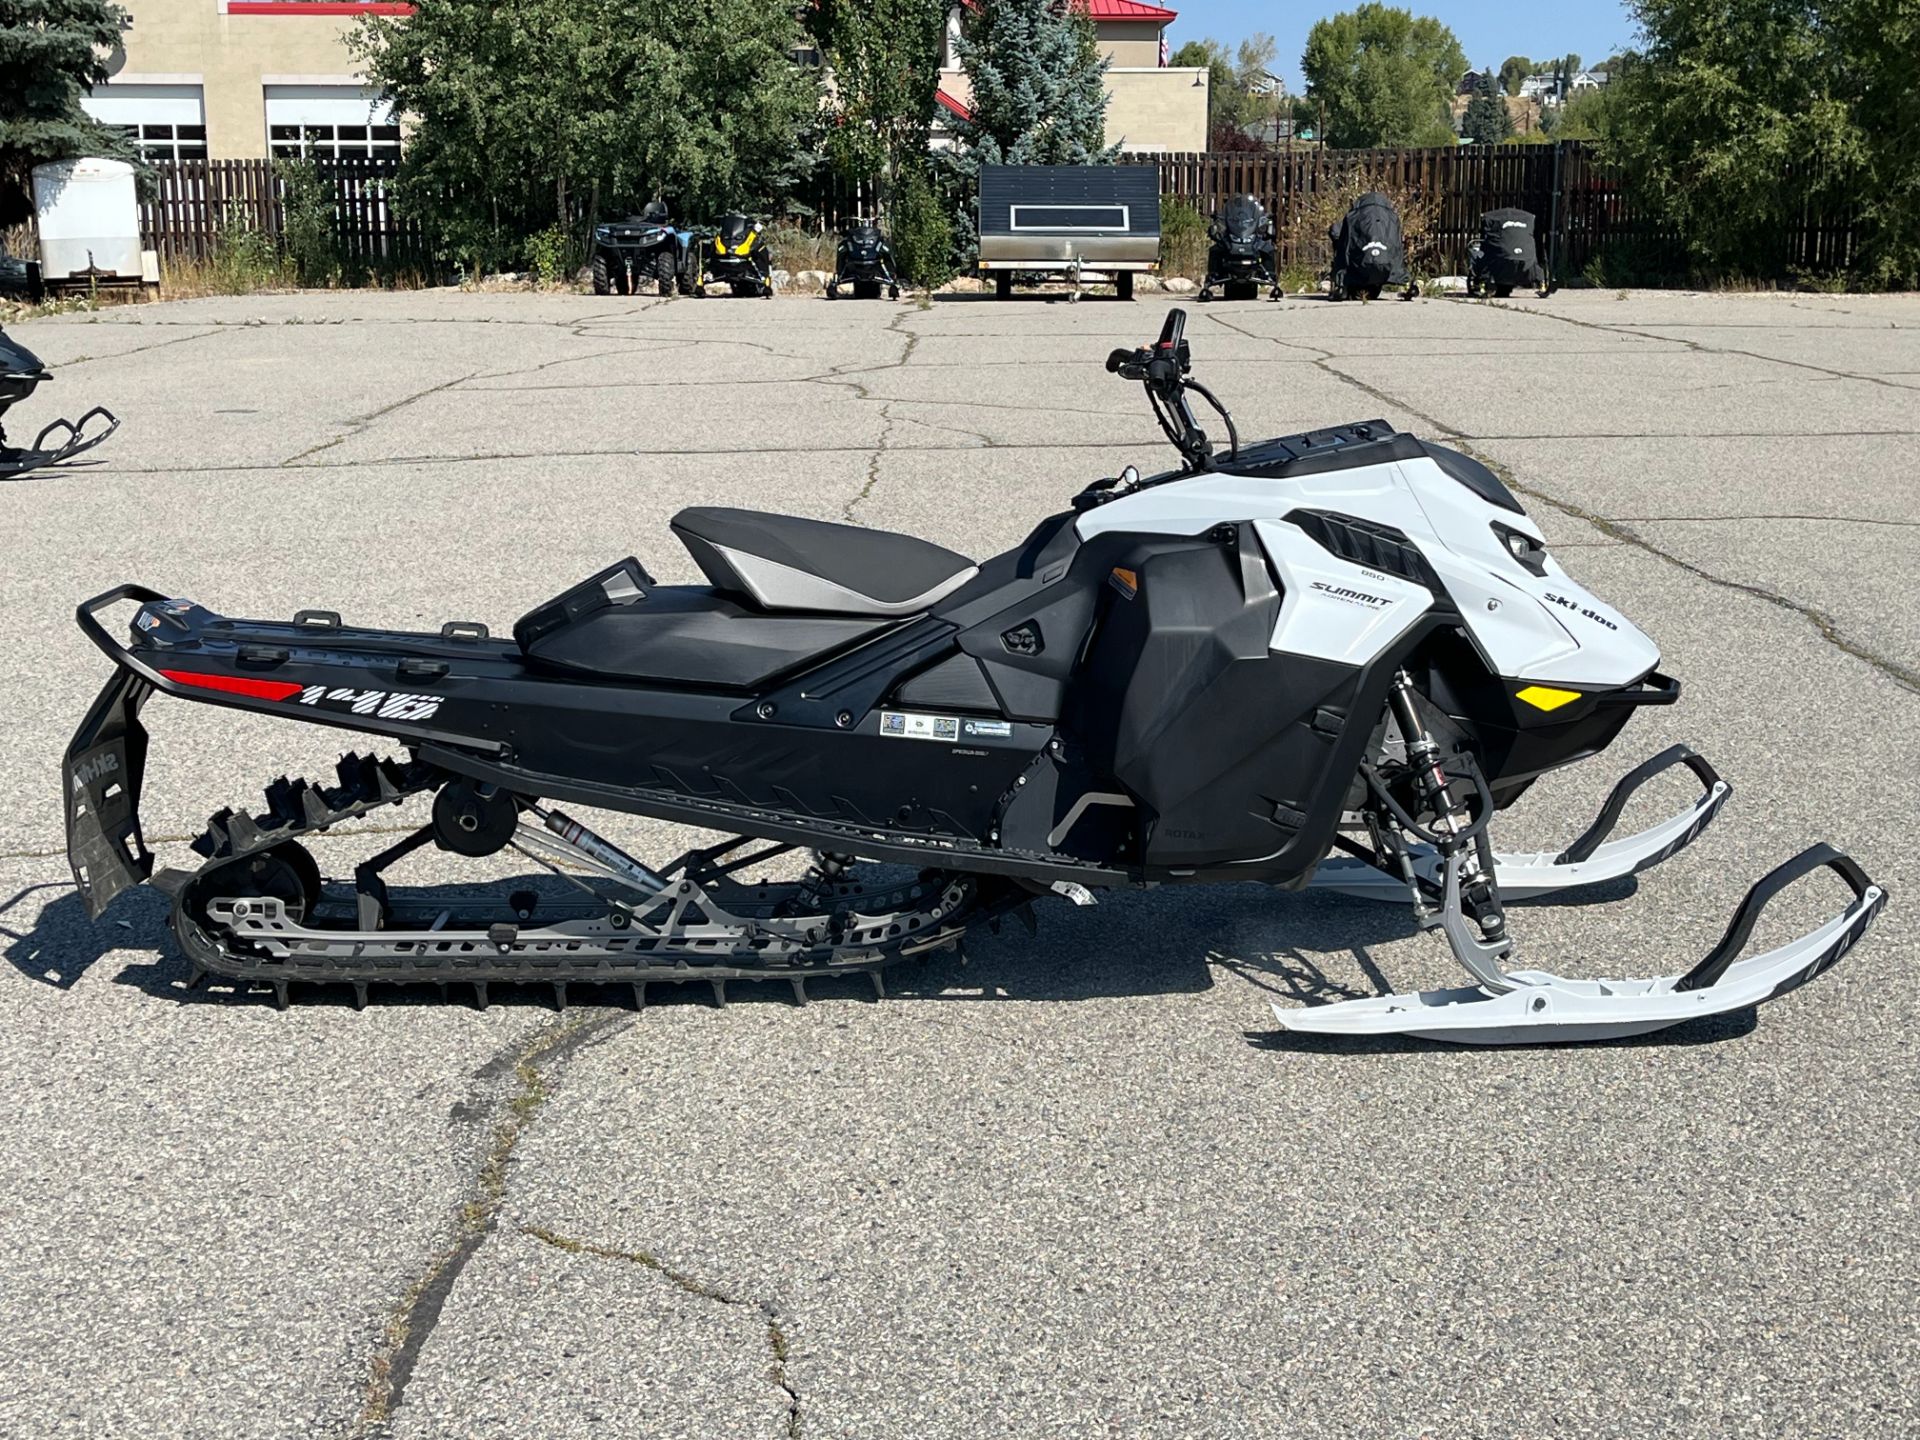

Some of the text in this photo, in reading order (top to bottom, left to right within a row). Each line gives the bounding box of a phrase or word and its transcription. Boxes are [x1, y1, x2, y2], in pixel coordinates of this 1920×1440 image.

[1361, 569, 1385, 582] 850
[1309, 581, 1393, 606] SUMMIT
[300, 685, 445, 721] 146
